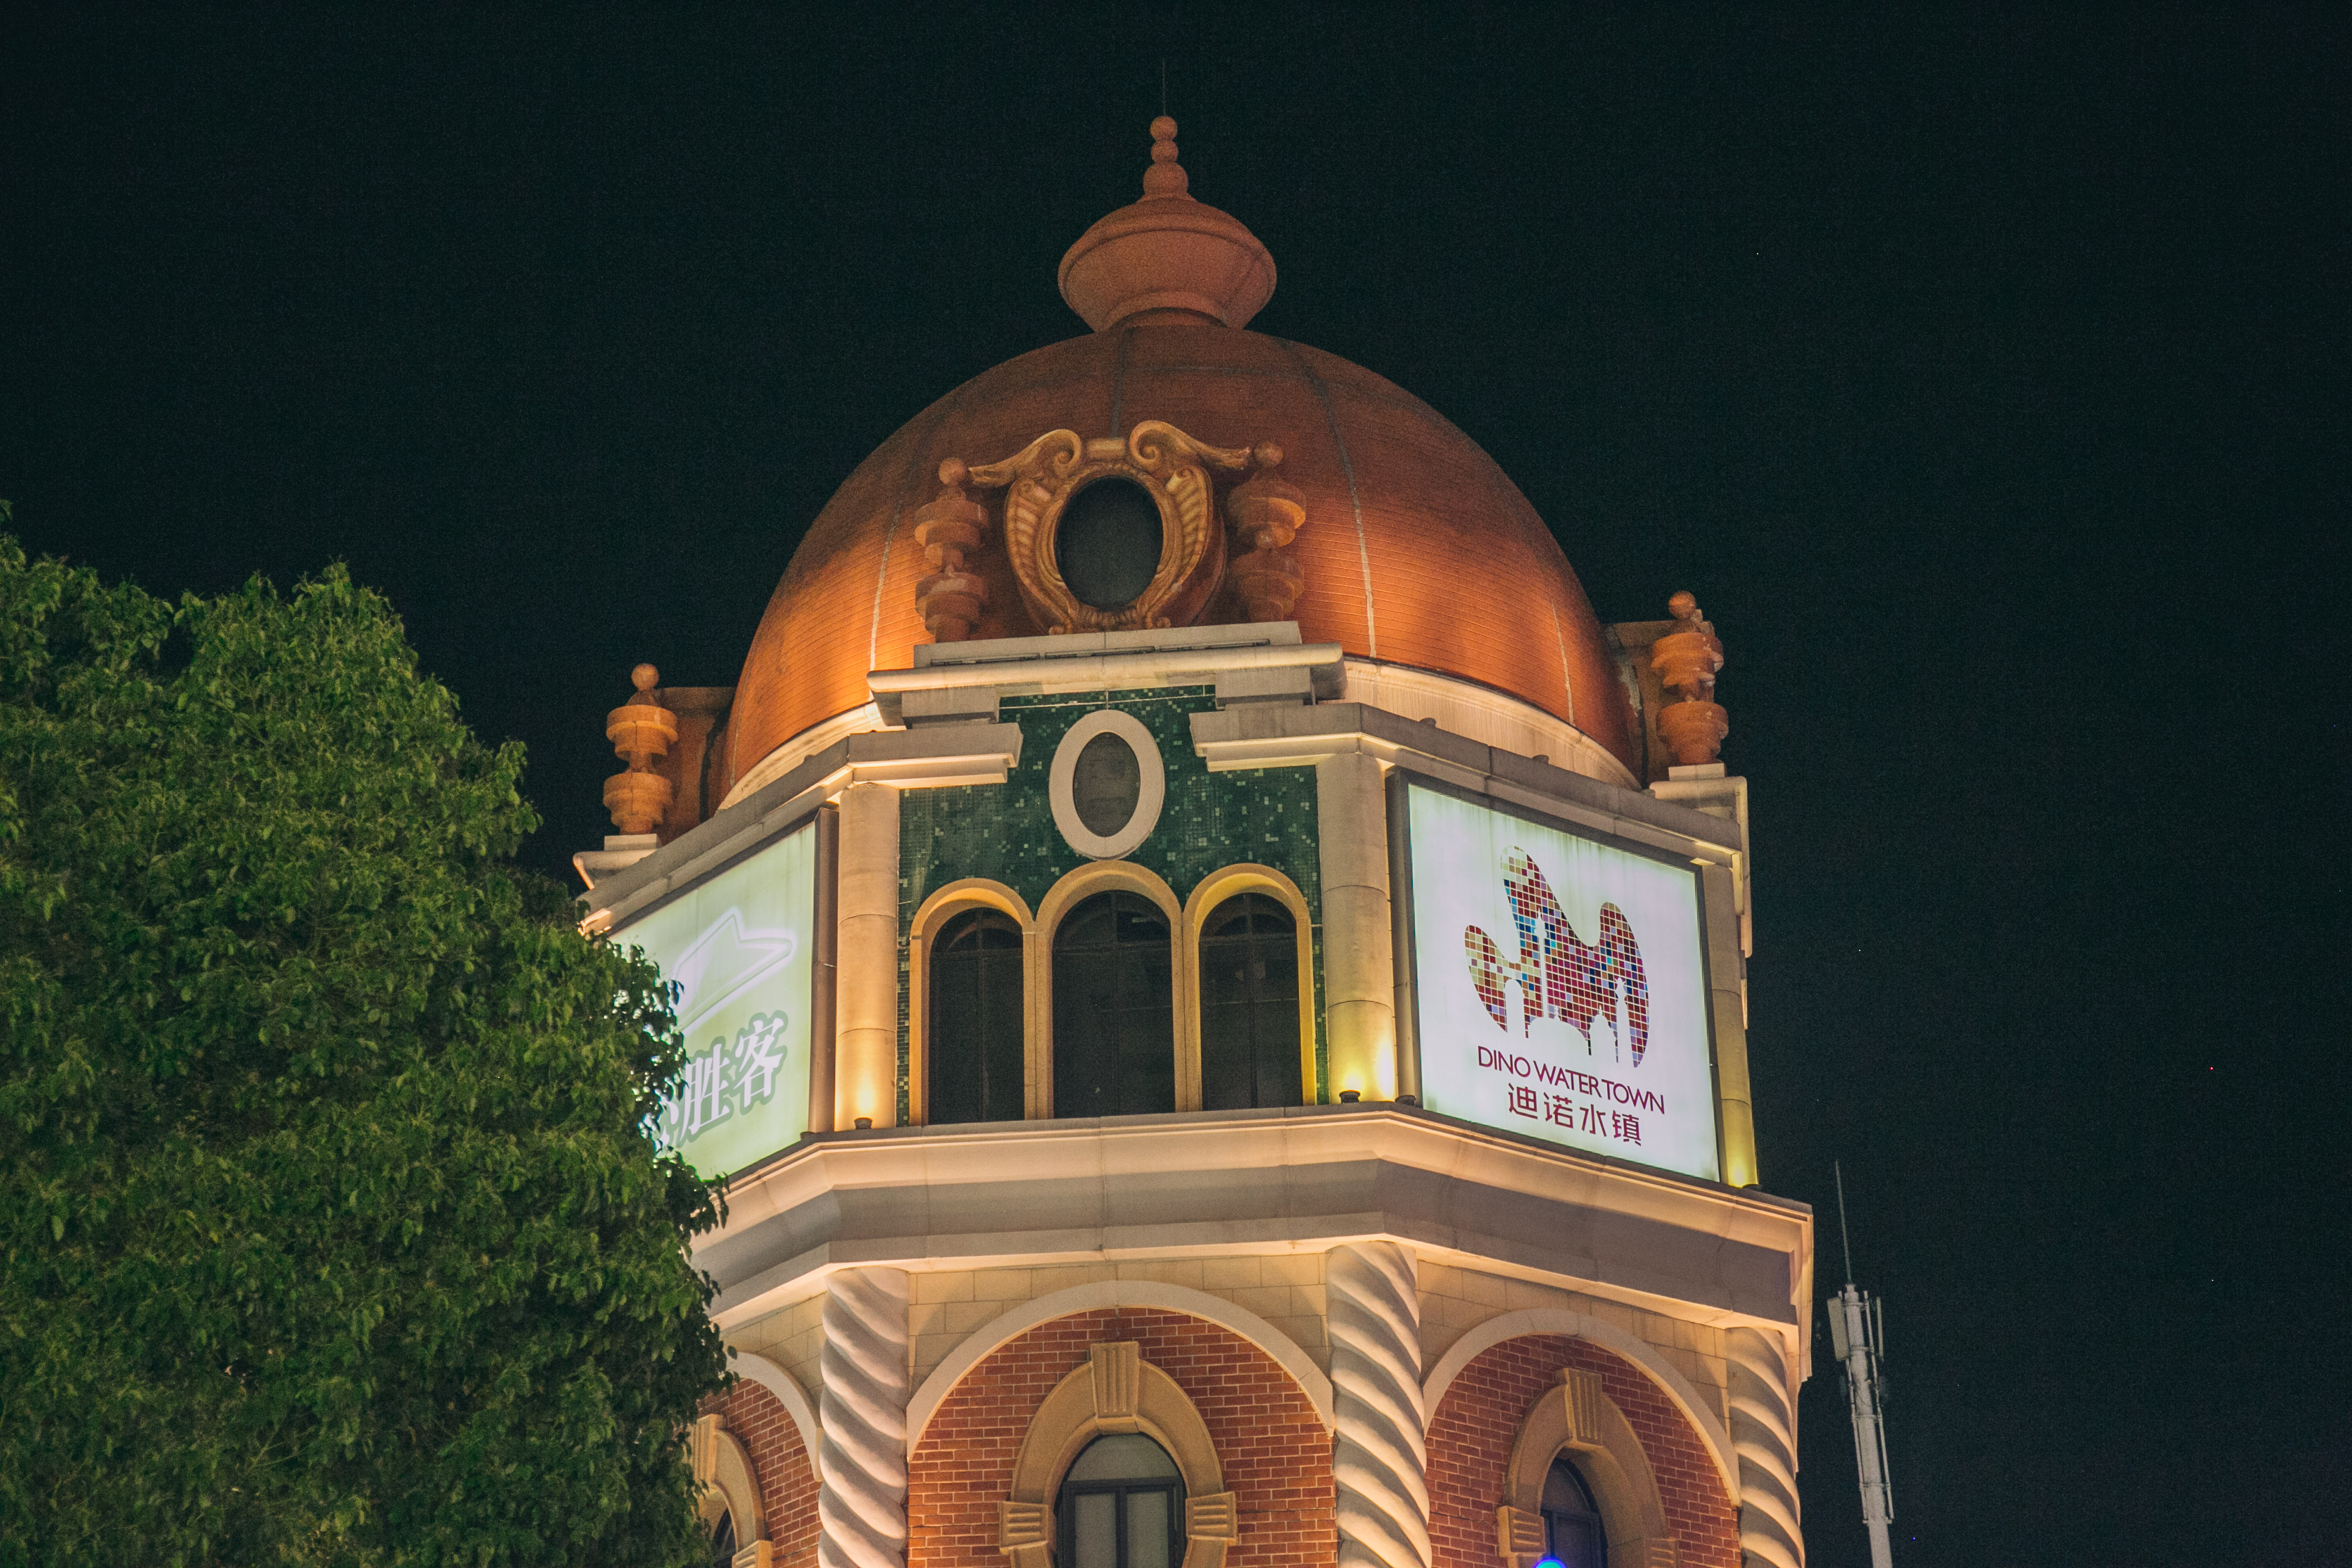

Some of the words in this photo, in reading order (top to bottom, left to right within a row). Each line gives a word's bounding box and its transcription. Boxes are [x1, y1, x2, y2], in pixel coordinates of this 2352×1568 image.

[1478, 1046, 1531, 1077] DINO
[1508, 1083, 1641, 1146] 迪诺水镇
